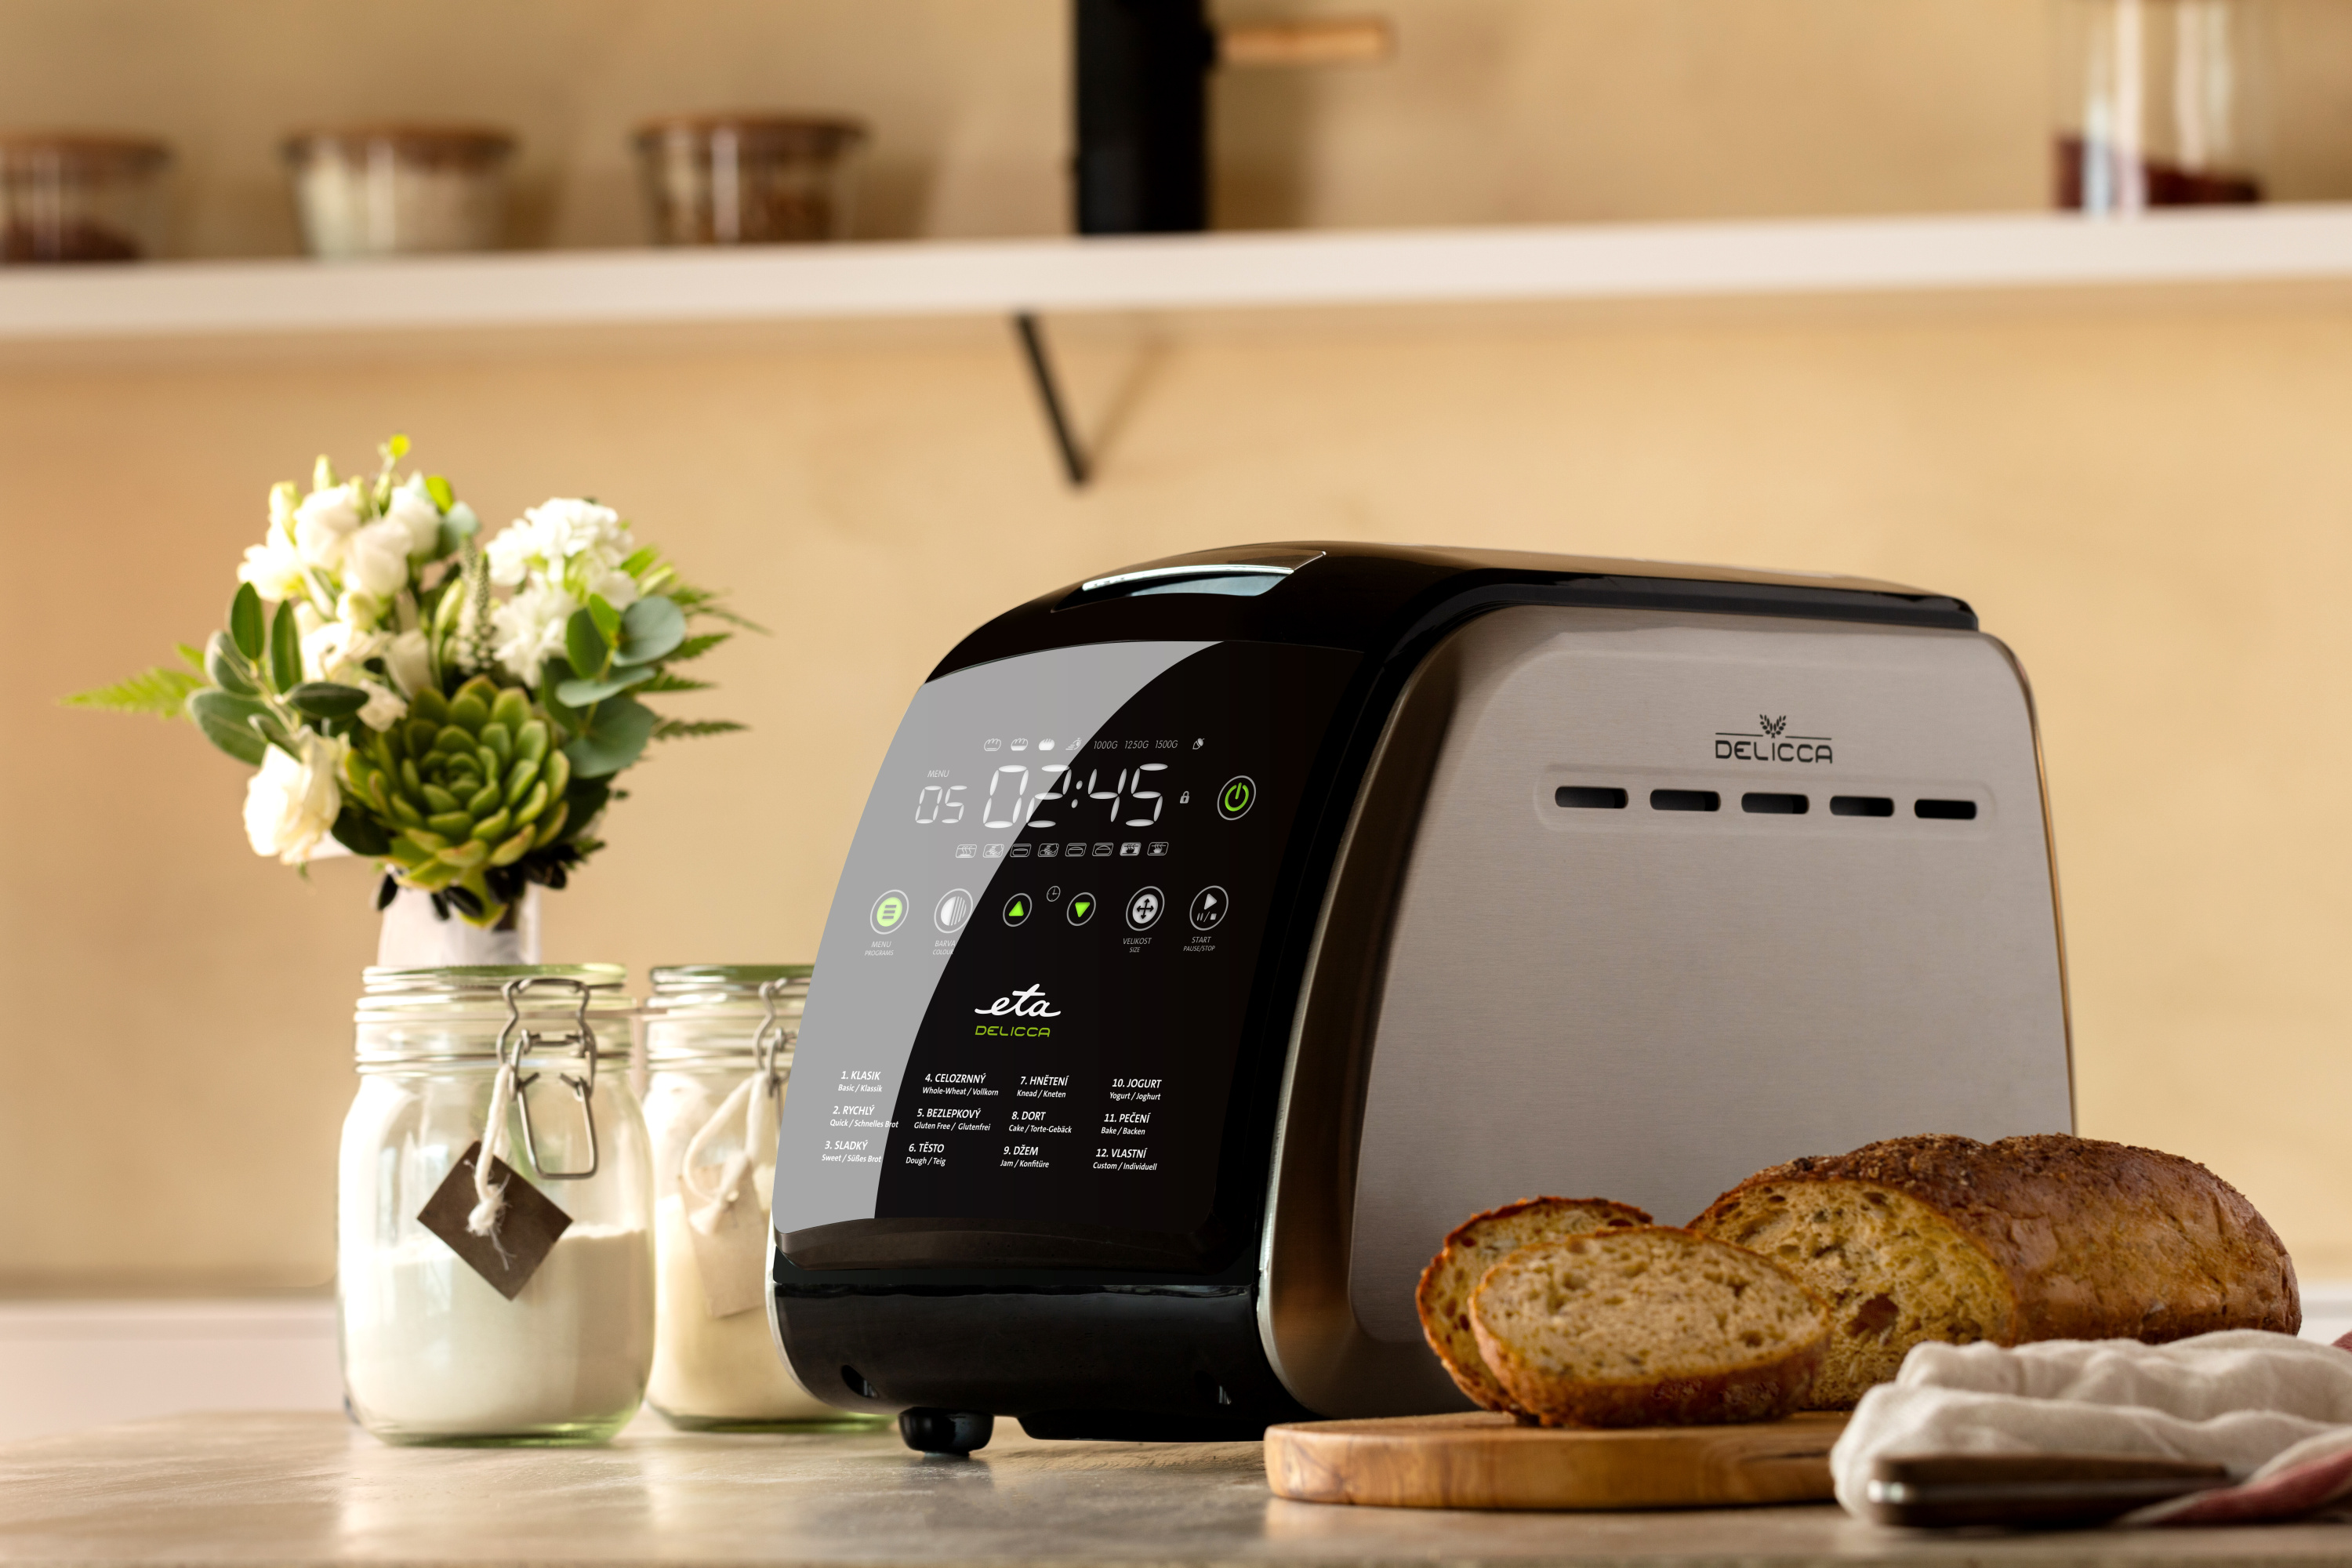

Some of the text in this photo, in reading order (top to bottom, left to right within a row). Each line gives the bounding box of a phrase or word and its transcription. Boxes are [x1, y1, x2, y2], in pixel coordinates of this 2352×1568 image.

[1094, 740, 1178, 750] 1000G 1250G 1500G
[1715, 740, 1833, 764] DELICCA
[983, 763, 1168, 829] 02:45
[915, 786, 967, 824] 05
[975, 983, 1062, 1018] eta
[975, 1025, 1051, 1037] DELICCA
[840, 1071, 881, 1080] 1. KLASIK
[925, 1073, 986, 1083] 4. CELOZRNNÝ
[1020, 1075, 1069, 1086] 7. HNĚTENÍ
[1112, 1078, 1162, 1088] 10. JOGURT
[923, 1087, 967, 1095] Whole-Wheat
[1109, 1092, 1131, 1101] Yogurt
[1136, 1093, 1161, 1102] Joghurt
[833, 1105, 875, 1116] 2. RYCHLÝ
[916, 1108, 982, 1119] 5. BEZLEPKOVÝ
[1011, 1111, 1046, 1120] 8. DORT
[1104, 1112, 1151, 1123] 11. PEČENÍ
[825, 1140, 868, 1150] 3. SLADKÝ
[909, 1142, 945, 1152] 6. TĚSTO
[1004, 1145, 1039, 1156] 9. DŽEM
[1096, 1148, 1148, 1158] 12. VLASTNÍ
[906, 1156, 927, 1166] Dough
[934, 1157, 946, 1167] Teig
